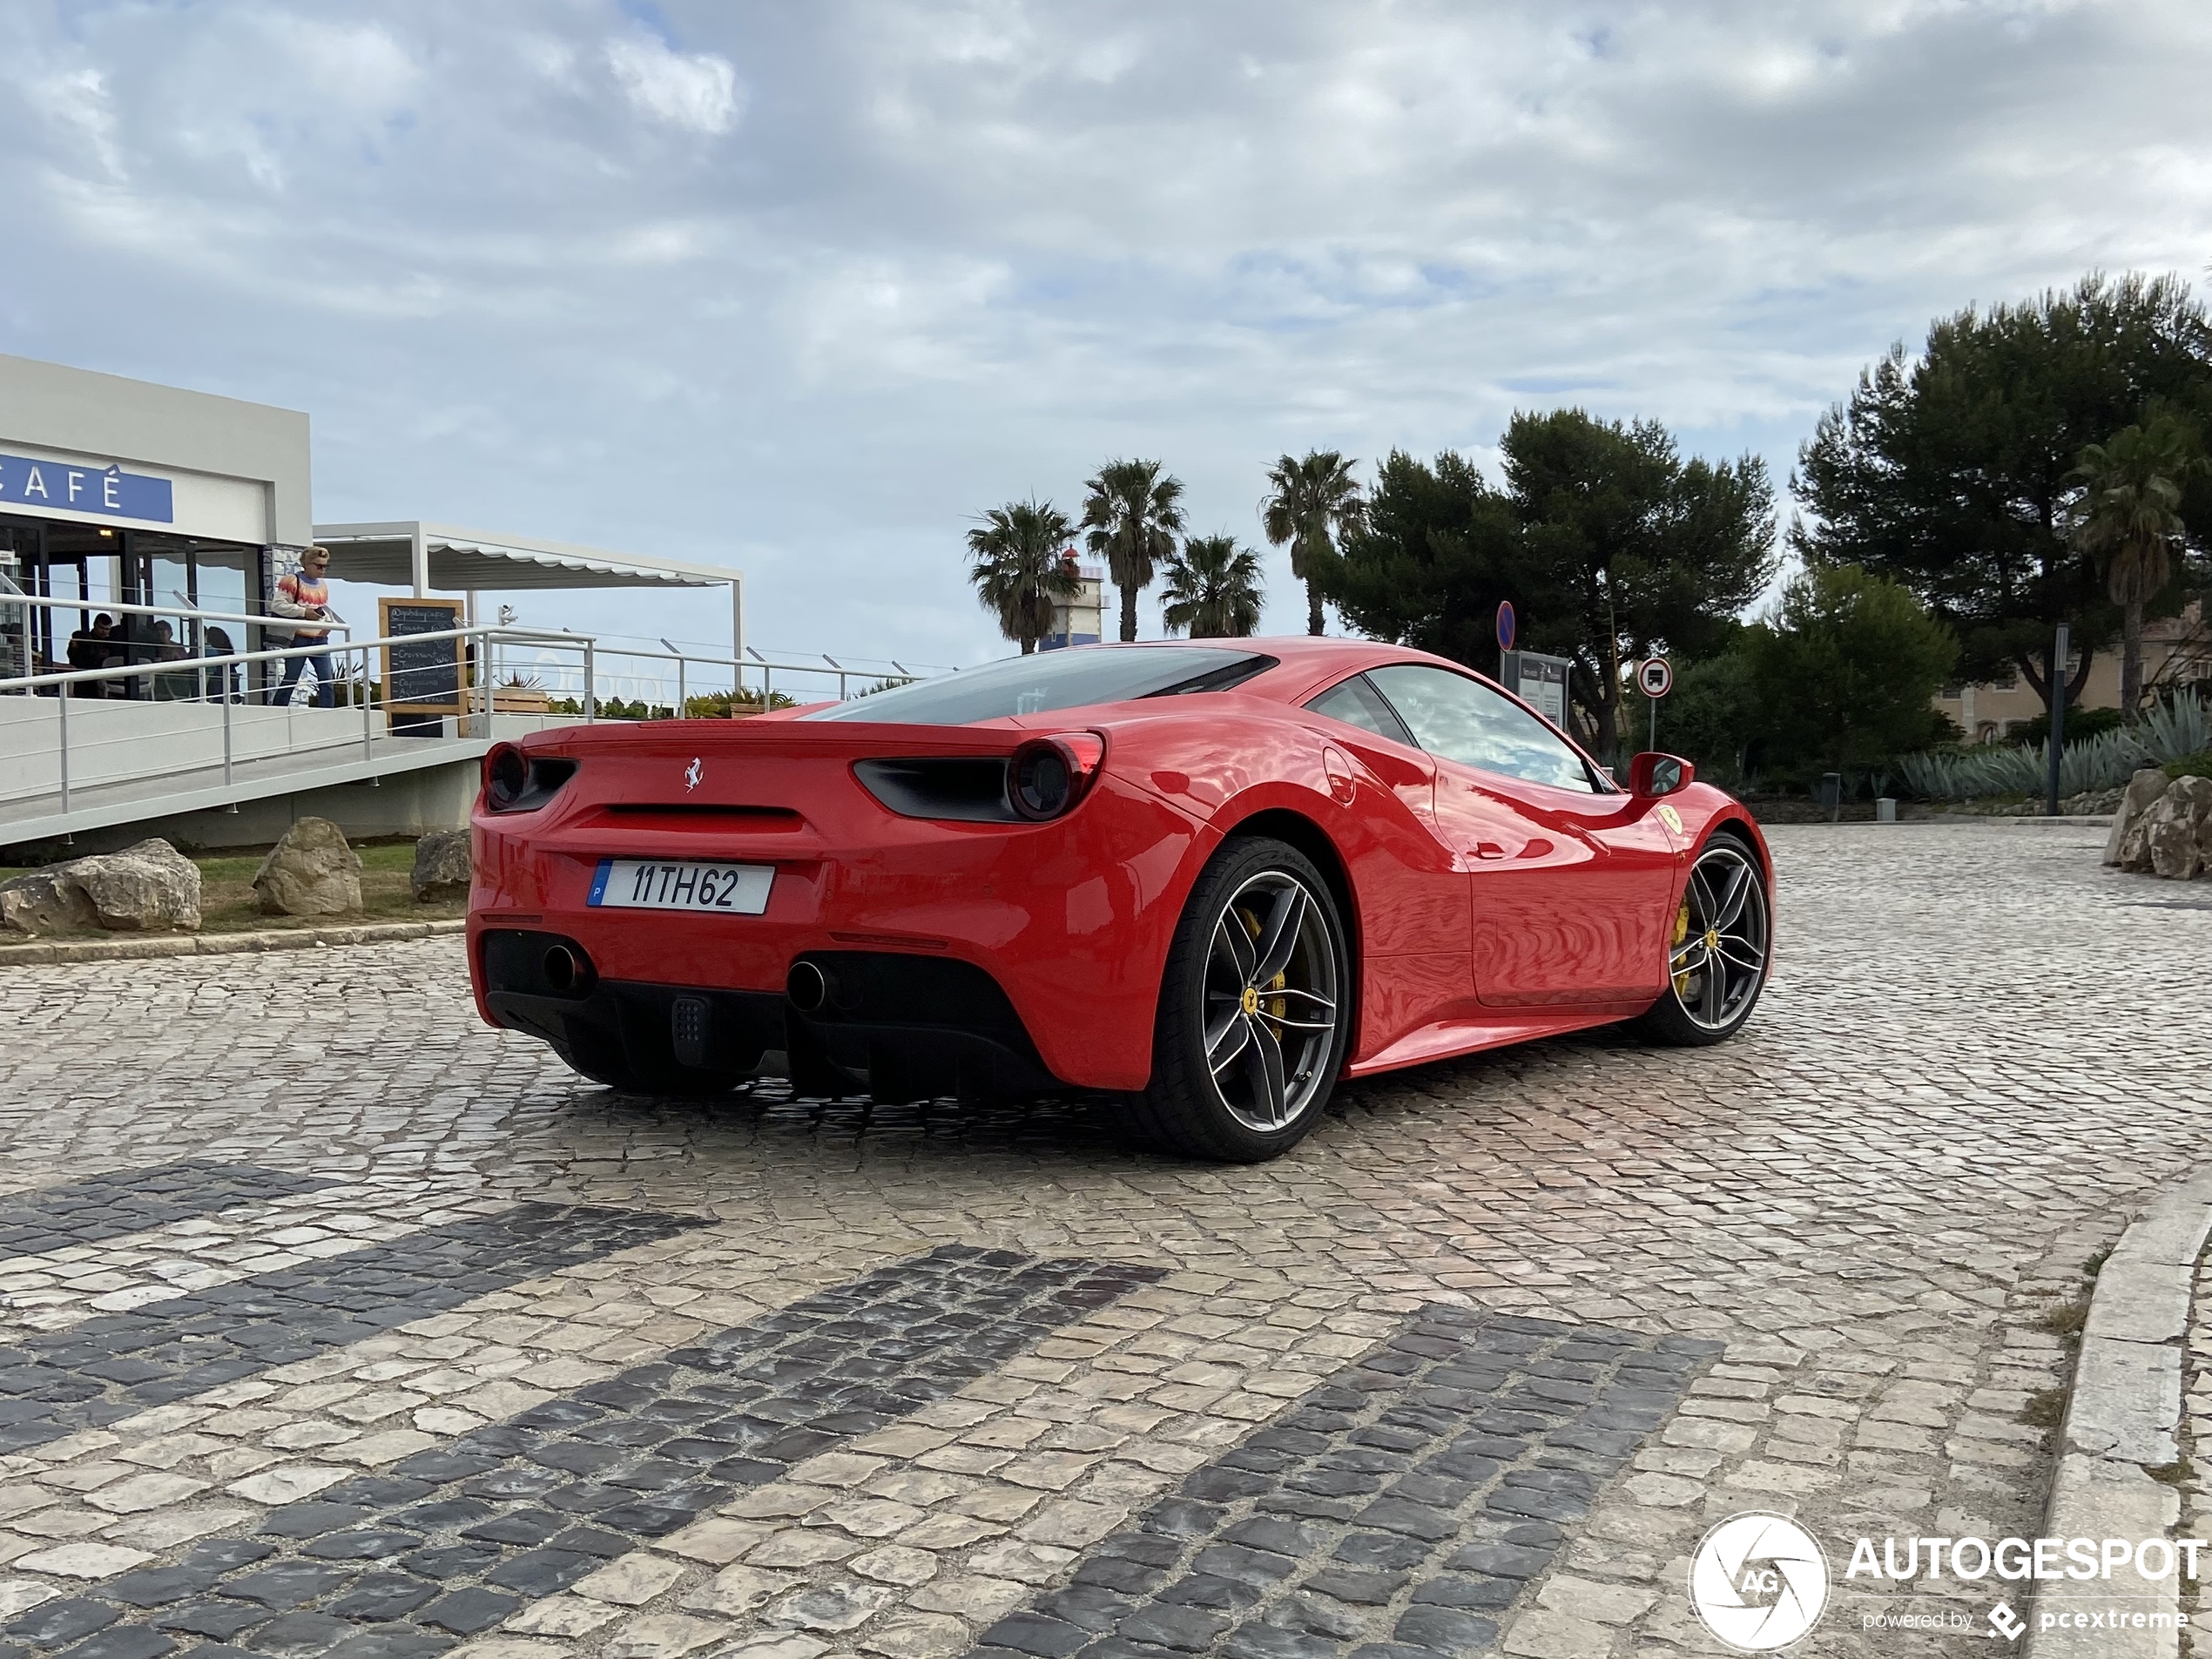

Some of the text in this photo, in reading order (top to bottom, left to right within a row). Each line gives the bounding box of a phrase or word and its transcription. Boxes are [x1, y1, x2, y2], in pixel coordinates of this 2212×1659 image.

[0, 465, 120, 508] AFÉ
[593, 887, 601, 897] P
[632, 866, 738, 907] 11TH62
